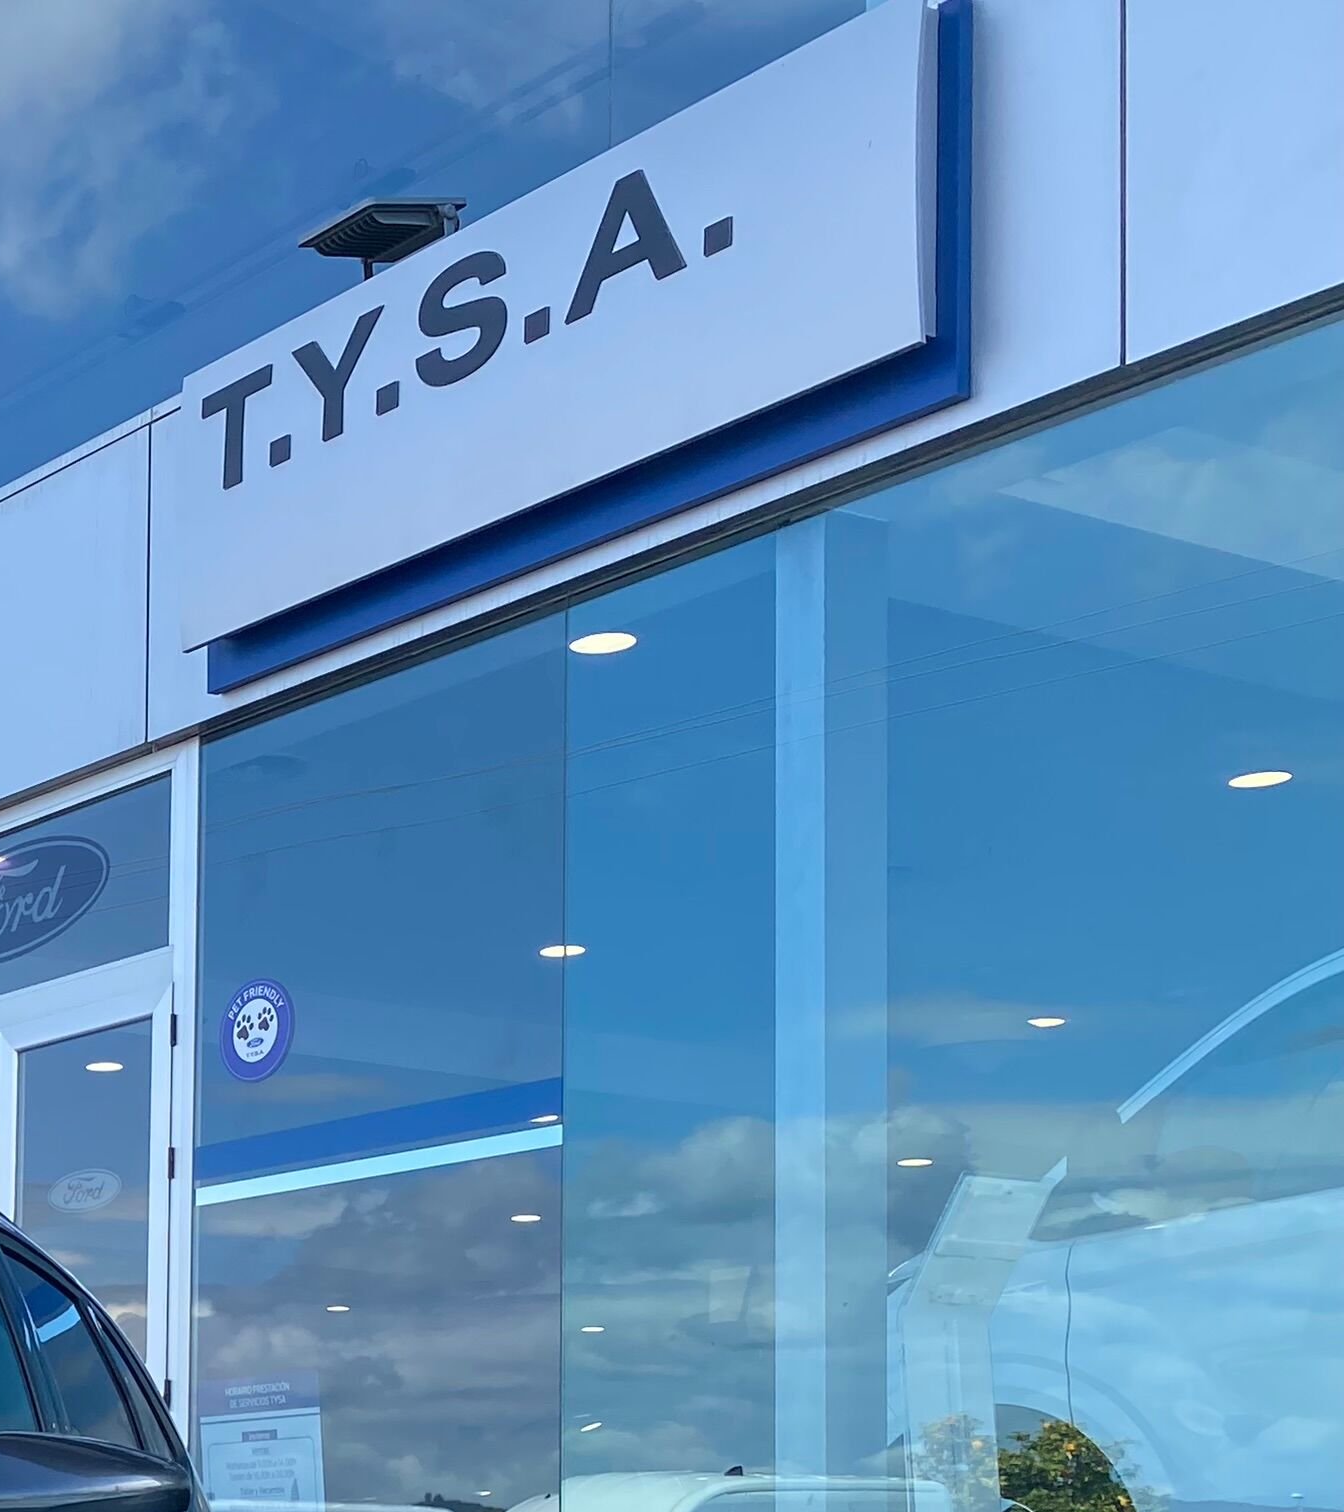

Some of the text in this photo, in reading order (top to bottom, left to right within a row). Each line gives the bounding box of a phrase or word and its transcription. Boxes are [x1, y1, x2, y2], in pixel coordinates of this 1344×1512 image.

[202, 169, 733, 489] T.Y.S.A.
[228, 985, 284, 1020] PET FRIENDLY
[63, 1176, 105, 1205] Ford
